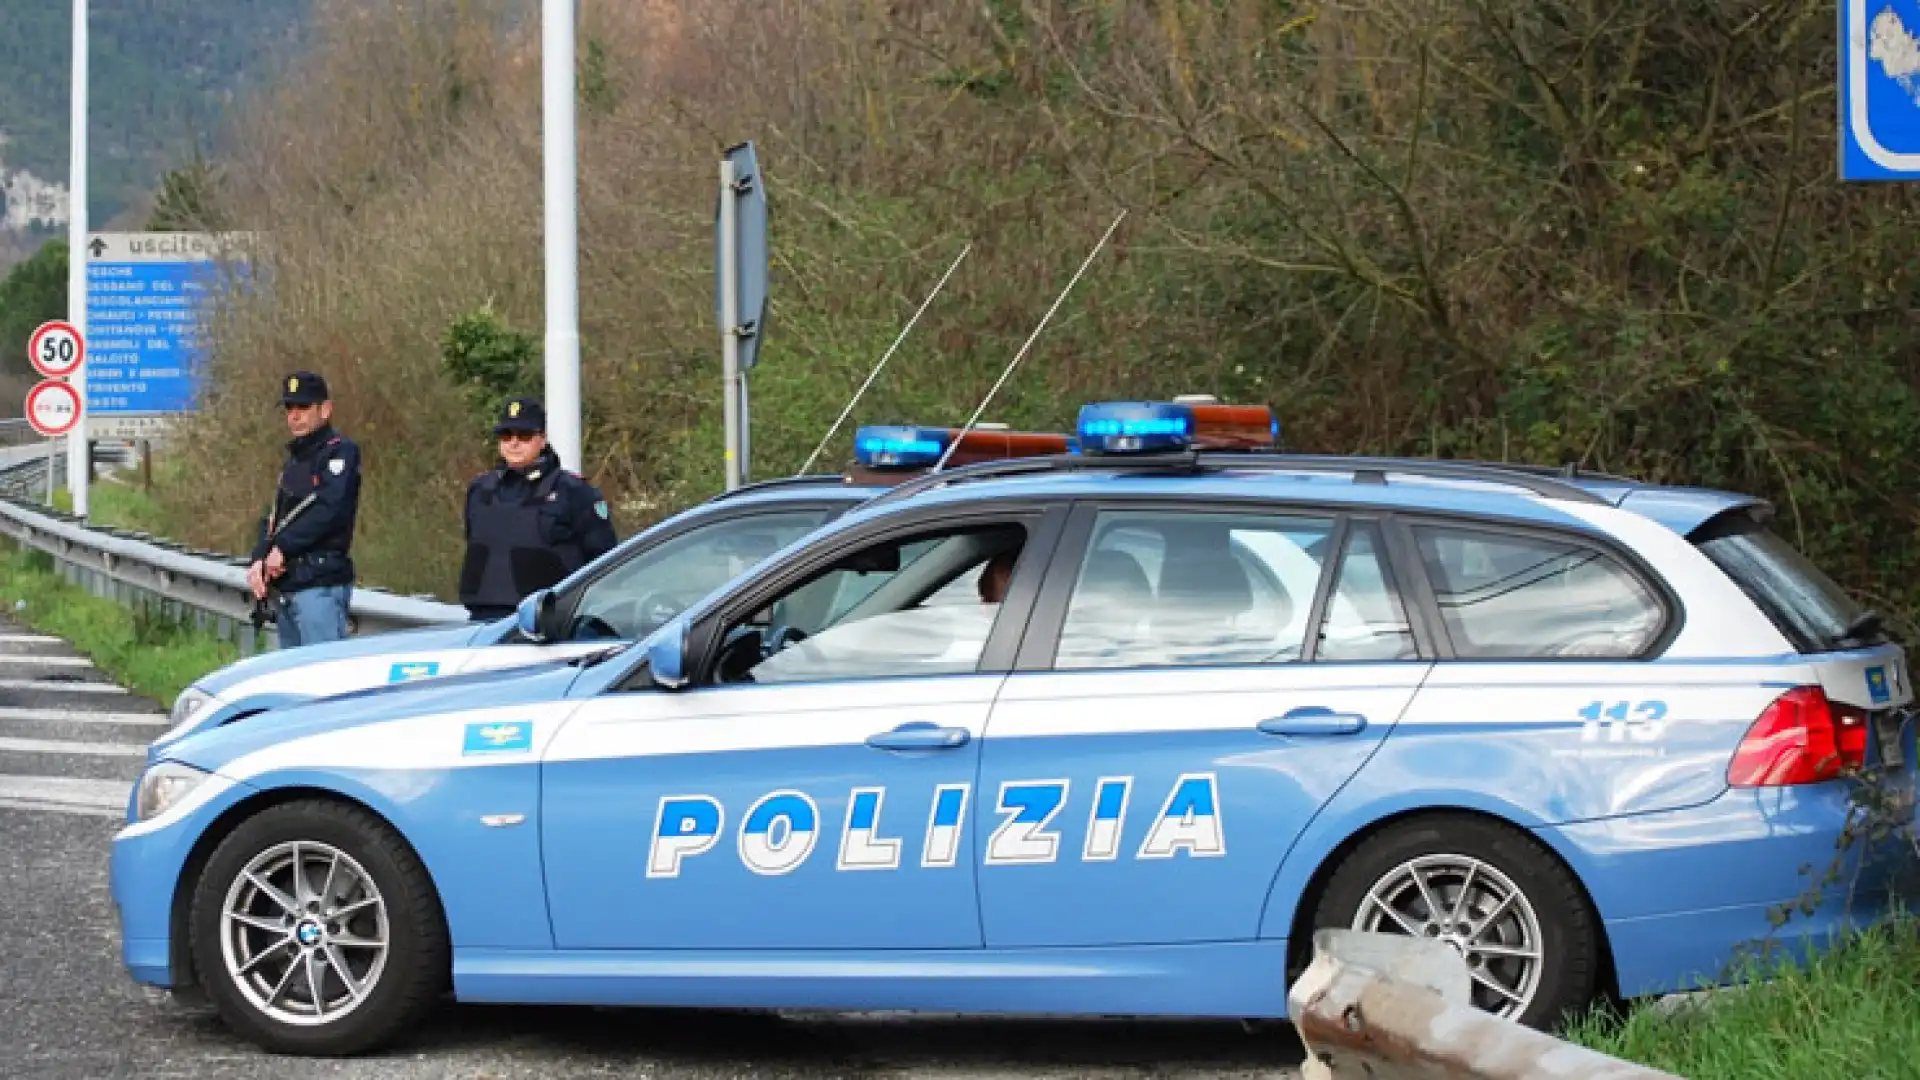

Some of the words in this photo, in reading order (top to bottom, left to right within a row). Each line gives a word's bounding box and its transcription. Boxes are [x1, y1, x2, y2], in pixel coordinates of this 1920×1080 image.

[129, 234, 204, 254] uscite
[43, 337, 73, 362] 50
[1577, 700, 1669, 742] 113
[646, 773, 1226, 878] POLIZIA
